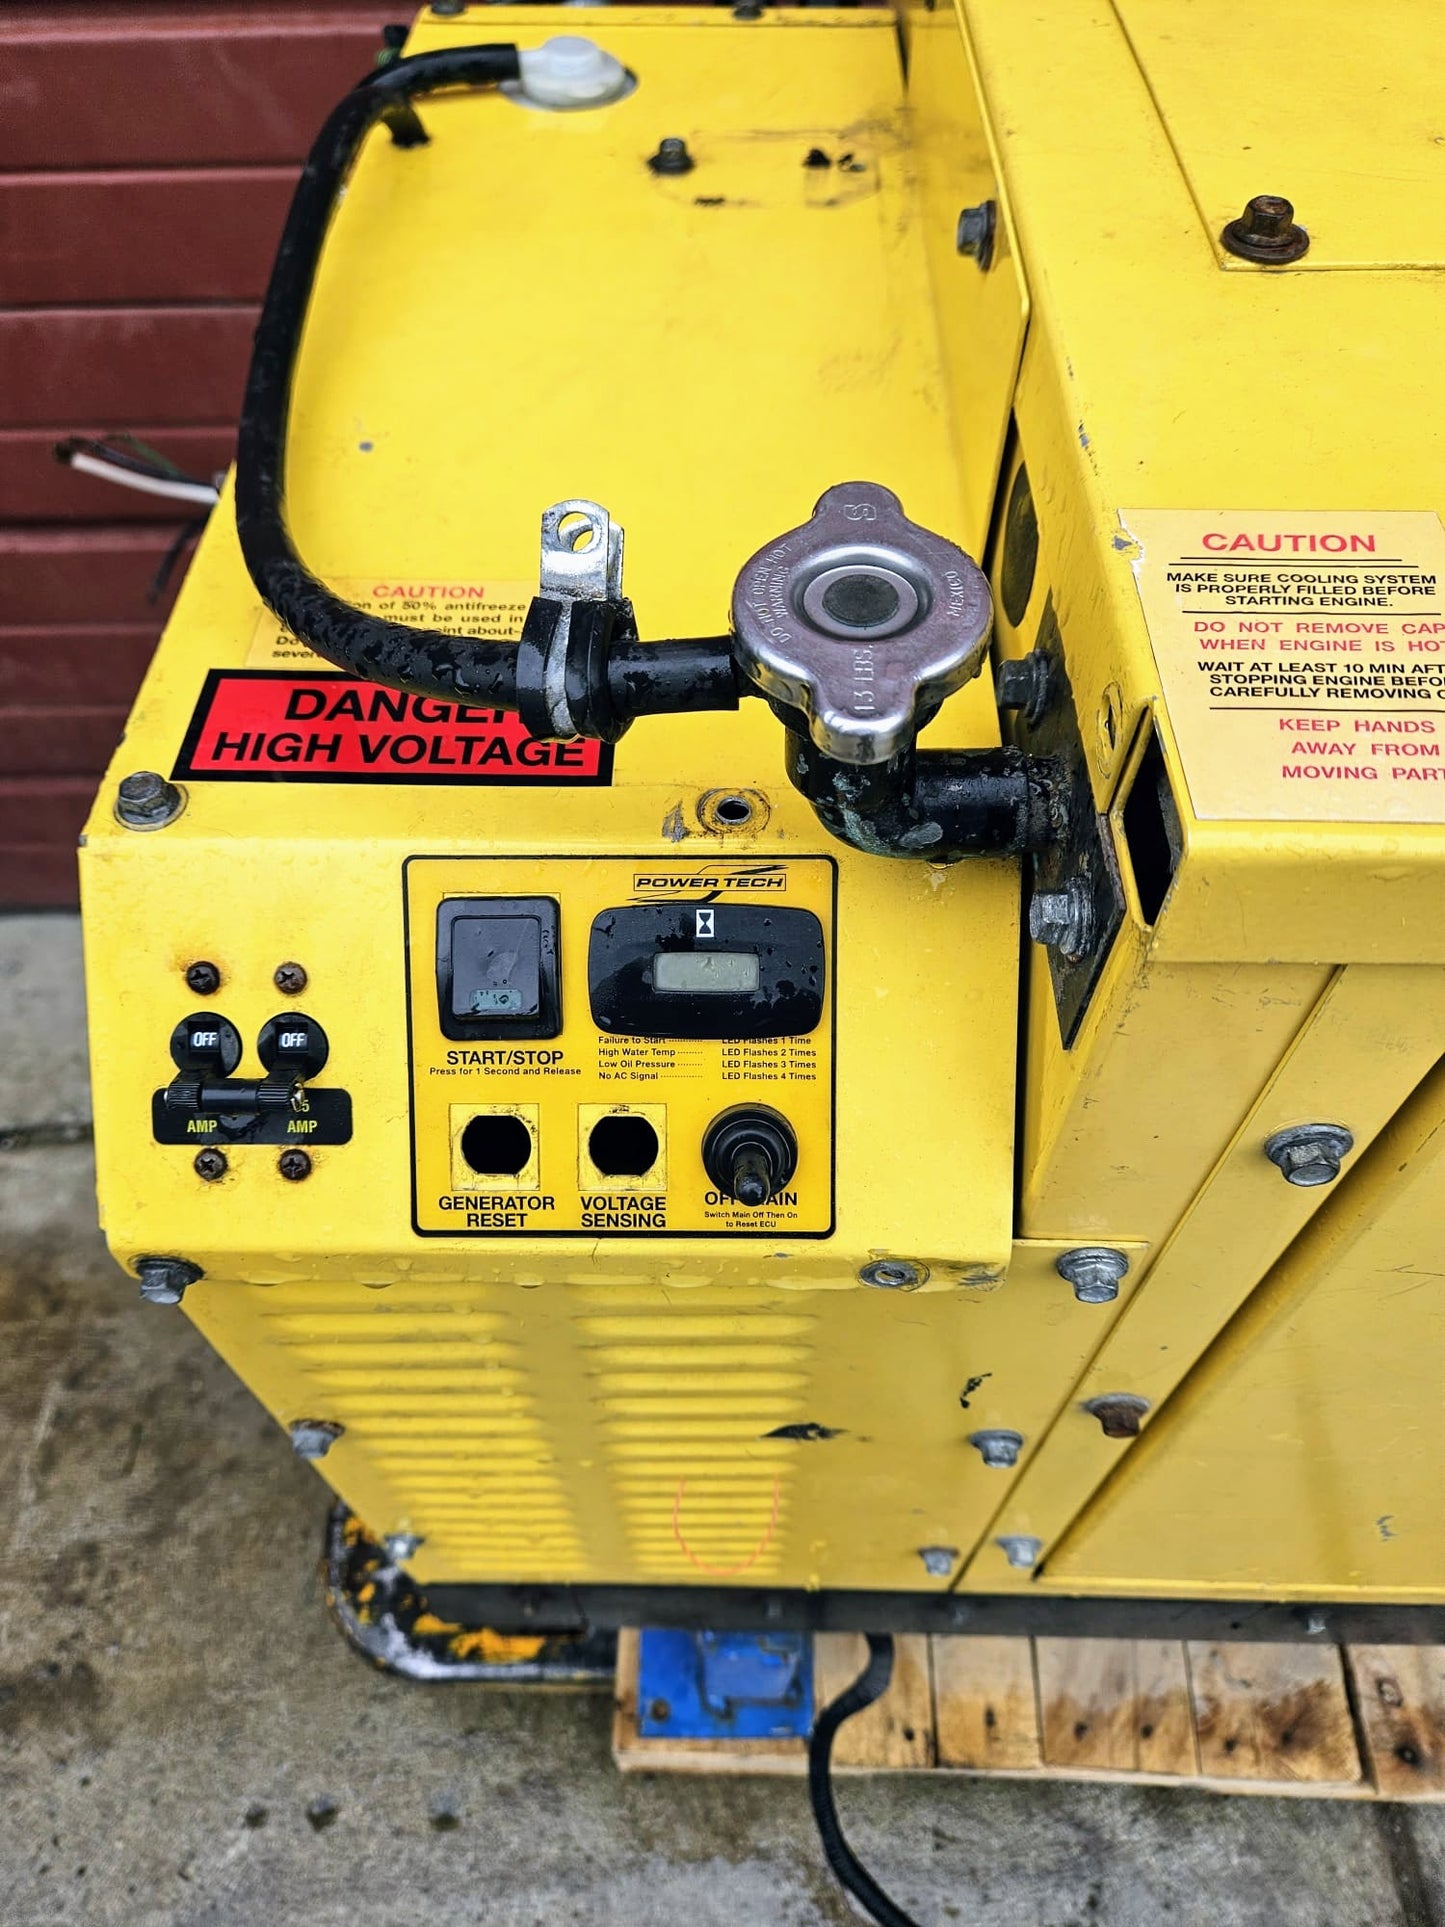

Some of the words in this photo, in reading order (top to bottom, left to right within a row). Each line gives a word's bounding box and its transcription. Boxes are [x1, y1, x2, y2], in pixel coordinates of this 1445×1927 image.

[1202, 533, 1376, 552] CAUTION
[765, 543, 792, 564] HOT
[752, 567, 771, 596] OPEN
[1166, 572, 1218, 582] MAKE
[1223, 573, 1271, 583] SURE
[1277, 574, 1359, 584] COOLING
[1364, 574, 1437, 585] SYSTEM
[372, 585, 485, 599] CAUTION
[769, 565, 790, 619] WARNING
[1175, 583, 1192, 593] IS
[1197, 584, 1291, 594] PROPERLY
[1296, 585, 1357, 595] FILLED
[1362, 585, 1436, 596] BEFORE
[379, 601, 395, 610] of
[402, 601, 437, 611] 50%
[445, 601, 526, 612] antifreeze
[1225, 596, 1314, 606] STARTING
[1319, 596, 1393, 607] ENGINE.
[383, 613, 424, 622] must
[432, 613, 452, 622] be
[460, 614, 501, 623] used
[509, 614, 523, 623] in
[752, 601, 775, 623] NOT
[1194, 621, 1225, 633] DO
[1238, 622, 1284, 633] NOT
[1296, 622, 1389, 634] REMOVE
[1401, 623, 1445, 634] CAP
[770, 626, 792, 644] DO
[1200, 638, 1266, 650] WHEN
[1280, 639, 1362, 651] ENGINE
[1375, 640, 1395, 652] IS
[1197, 661, 1245, 672] WAIT
[1249, 662, 1273, 672] AT
[1279, 662, 1338, 673] LEAST
[1344, 663, 1363, 673] 10
[1369, 663, 1405, 674] MIN
[1411, 664, 1445, 674] AFT
[1210, 674, 1307, 685] STOPPING
[1312, 675, 1387, 686] ENGINE
[1391, 675, 1445, 687] BEFO
[853, 690, 876, 710] 13
[1210, 687, 1319, 698] CAREFULLY
[1327, 688, 1432, 700] REMOVING
[285, 689, 520, 723] DANGE
[1279, 718, 1340, 732] KEEP
[1354, 720, 1436, 734] HANDS
[211, 732, 348, 763] HIGH
[359, 735, 587, 767] VOLTAGE
[1291, 742, 1356, 755] AWAY
[1371, 743, 1440, 757] FROM
[1282, 765, 1378, 780] MOVING
[636, 877, 720, 888] POWER
[722, 877, 784, 888] TECH
[193, 1032, 217, 1047] OFF
[281, 1033, 306, 1048] OFF
[598, 1036, 629, 1044] Failure
[781, 1036, 786, 1044] 1
[789, 1036, 811, 1044] Time
[446, 1050, 563, 1065] START/STOP
[598, 1048, 619, 1057] High
[622, 1048, 648, 1056] Water
[652, 1048, 676, 1057] Temp
[722, 1048, 741, 1056] LED
[743, 1048, 778, 1056] Flashes
[781, 1048, 786, 1056] 2
[789, 1048, 817, 1056] Times
[460, 1067, 472, 1075] for
[484, 1067, 520, 1075] Second
[523, 1067, 541, 1075] and
[544, 1067, 582, 1075] Release
[598, 1060, 617, 1068] Low
[620, 1060, 633, 1068] Oil
[636, 1060, 676, 1068] Pressure
[722, 1060, 741, 1068] LED
[743, 1060, 778, 1068] Flashes
[781, 1060, 786, 1068] 3
[789, 1060, 817, 1068] Times
[598, 1072, 612, 1080] No
[614, 1072, 627, 1080] AC
[630, 1072, 659, 1081] Signal
[722, 1072, 741, 1080] LED
[743, 1072, 778, 1080] Flashes
[781, 1072, 786, 1080] 4
[789, 1072, 817, 1080] Times
[187, 1120, 218, 1133] AMP
[287, 1120, 318, 1133] AMP
[438, 1196, 555, 1211] GENERATOR
[580, 1196, 667, 1211] VOLTAGE
[704, 1191, 735, 1206] OF
[763, 1192, 798, 1206] AIN
[467, 1213, 528, 1227] RESET
[581, 1213, 666, 1228] SENSING
